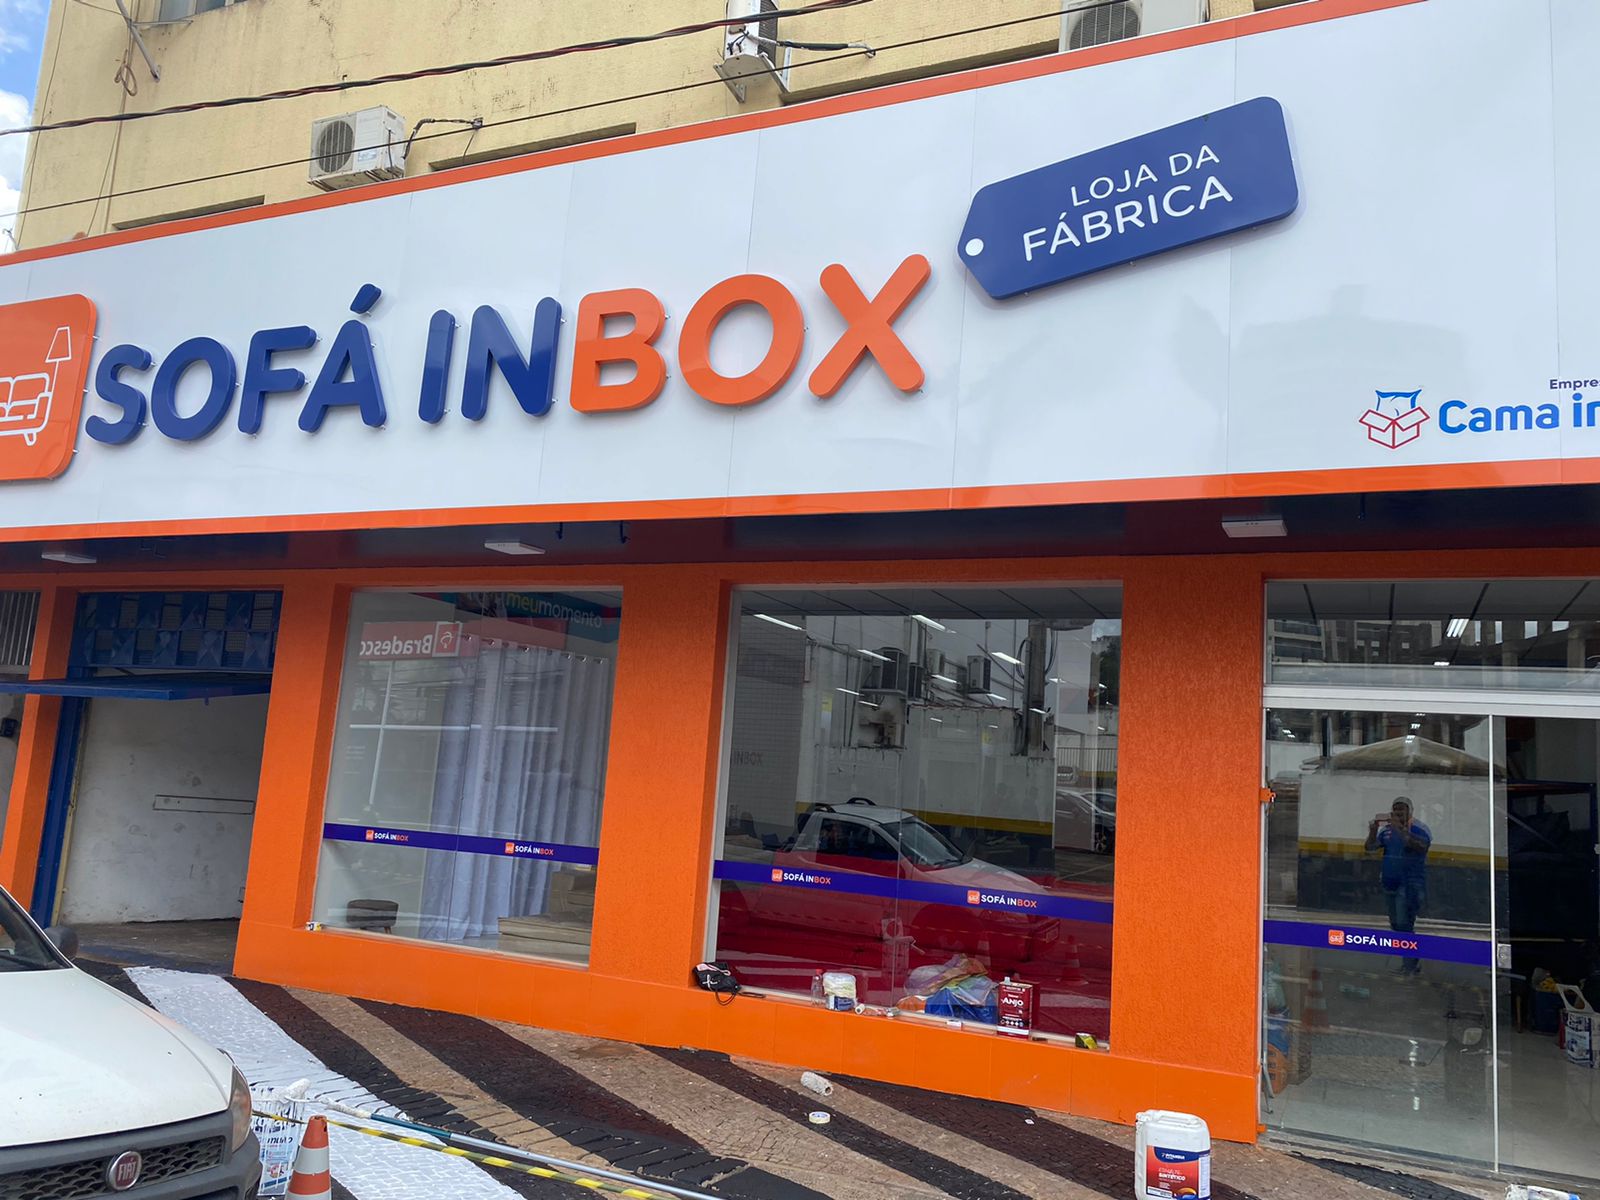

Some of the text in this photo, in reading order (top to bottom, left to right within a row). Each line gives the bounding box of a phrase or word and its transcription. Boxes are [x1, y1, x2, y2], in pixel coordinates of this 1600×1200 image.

[1070, 145, 1220, 207] LOJA DA
[1023, 175, 1233, 262] FÁBRICA
[85, 254, 932, 445] SOFÁ INBOX
[1550, 379, 1600, 391] Empre
[1439, 399, 1560, 434] Cama
[374, 832, 390, 840] SOFÁ
[515, 845, 554, 856] SOFÁ INBOX
[783, 872, 831, 885] SOFÁ INBOX
[981, 894, 1037, 908] SOFÁ INBOX
[1346, 934, 1418, 950] SOFÁ INBOX
[117, 1161, 137, 1181] FIAT
